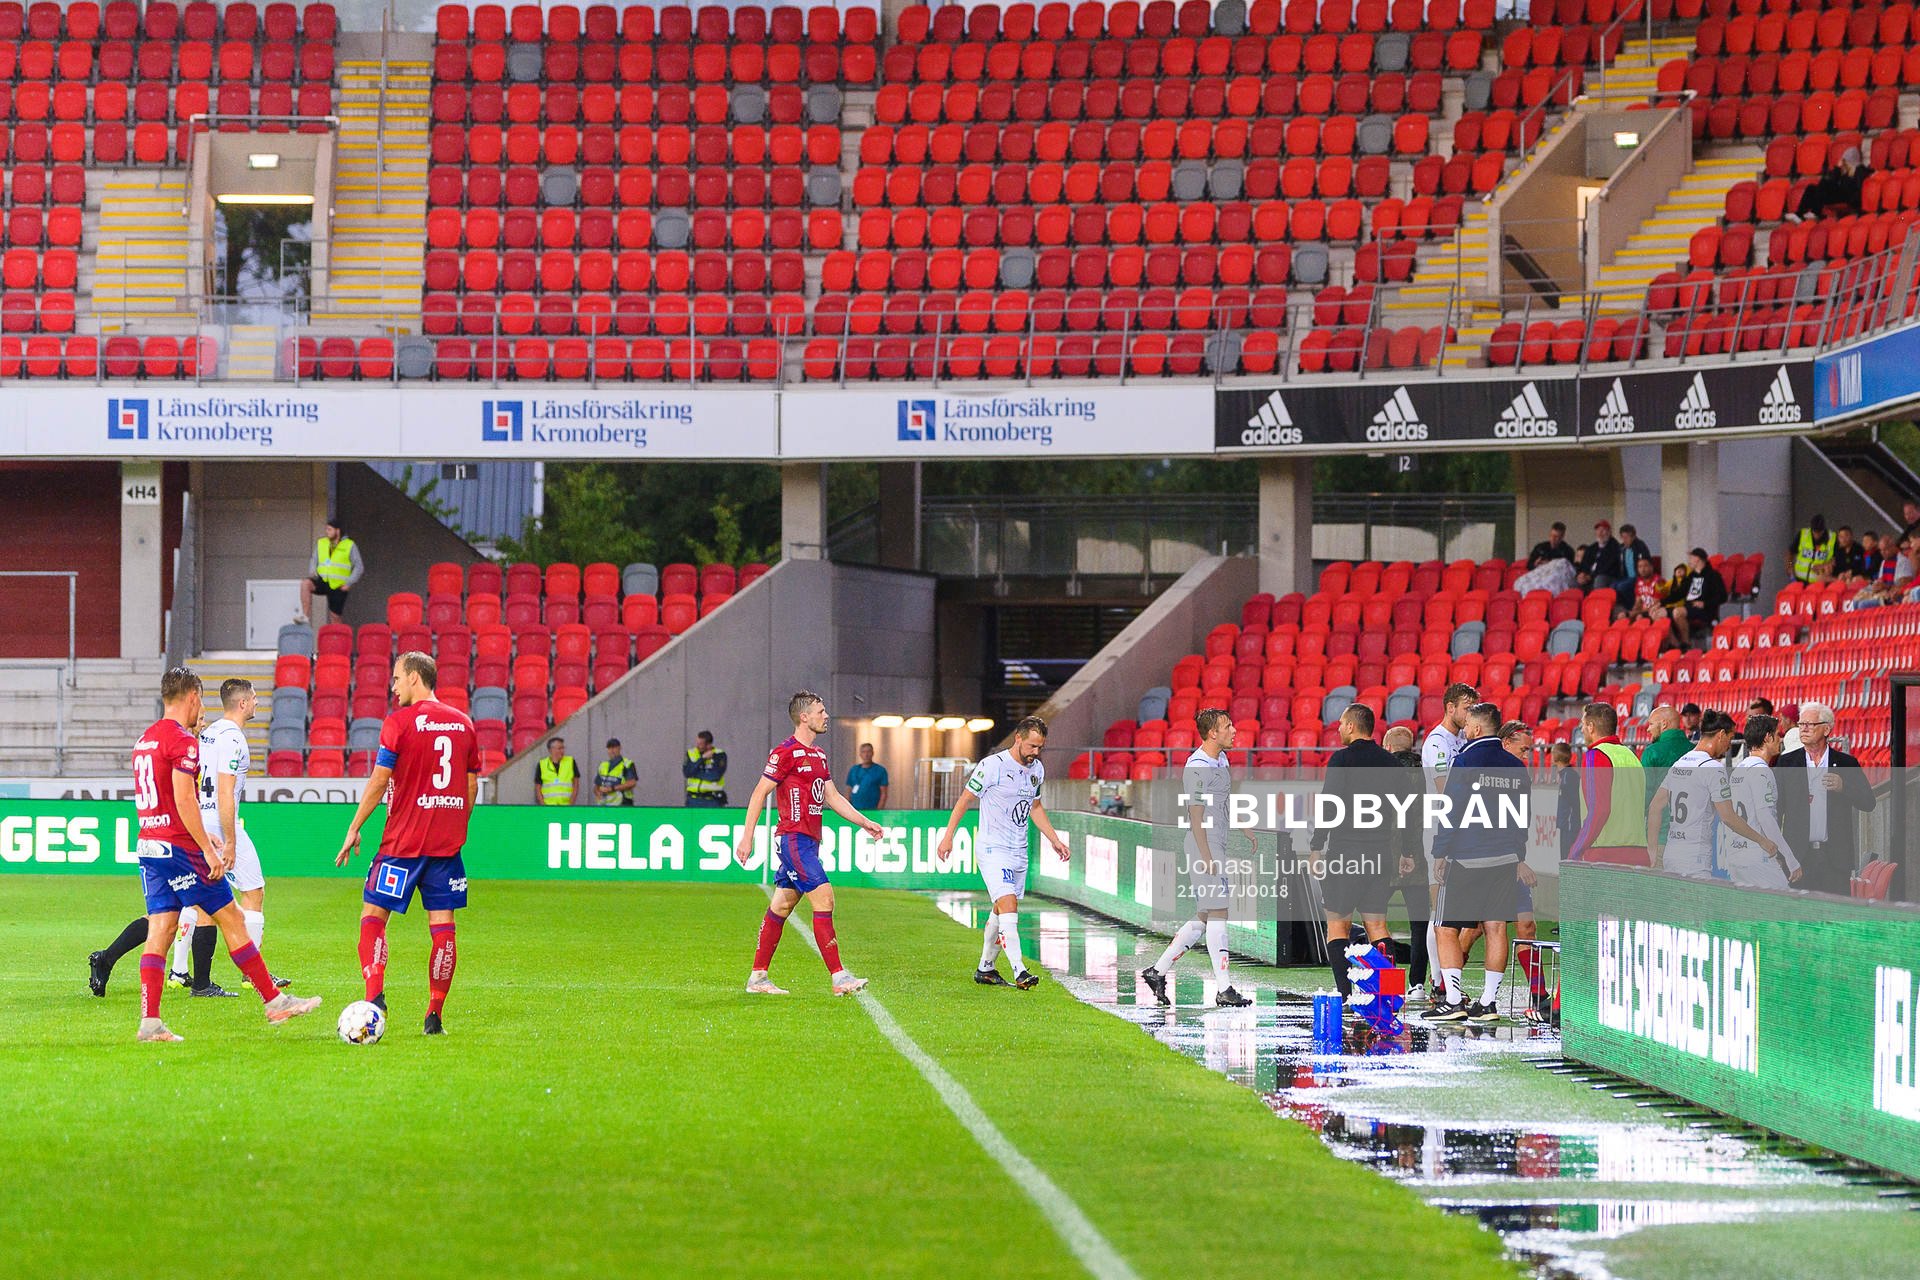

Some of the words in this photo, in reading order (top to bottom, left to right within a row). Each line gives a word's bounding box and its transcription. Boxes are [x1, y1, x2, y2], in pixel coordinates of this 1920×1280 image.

[157, 398, 319, 423] Länsförsäkring
[532, 399, 693, 425] Länsförsäkring
[944, 397, 1096, 421] Länsförsäkring
[1675, 408, 1716, 430] adidas
[1759, 403, 1801, 424] adidas
[157, 421, 273, 446] Kronoberg
[944, 420, 1053, 446] Kronoberg
[1241, 423, 1303, 446] adidas
[1366, 421, 1429, 442] adidas
[1494, 417, 1558, 438] adidas
[1595, 412, 1634, 434] adidas
[532, 423, 648, 448] Kronoberg
[134, 486, 158, 499] H4
[432, 735, 453, 790] 3
[134, 754, 159, 811] 33
[1512, 777, 1521, 790] IF
[417, 794, 464, 809] dynacon
[548, 822, 684, 870] HELA
[912, 826, 972, 874] LIGA
[1598, 913, 1633, 1034] HELA
[1713, 935, 1756, 1073] LIGA
